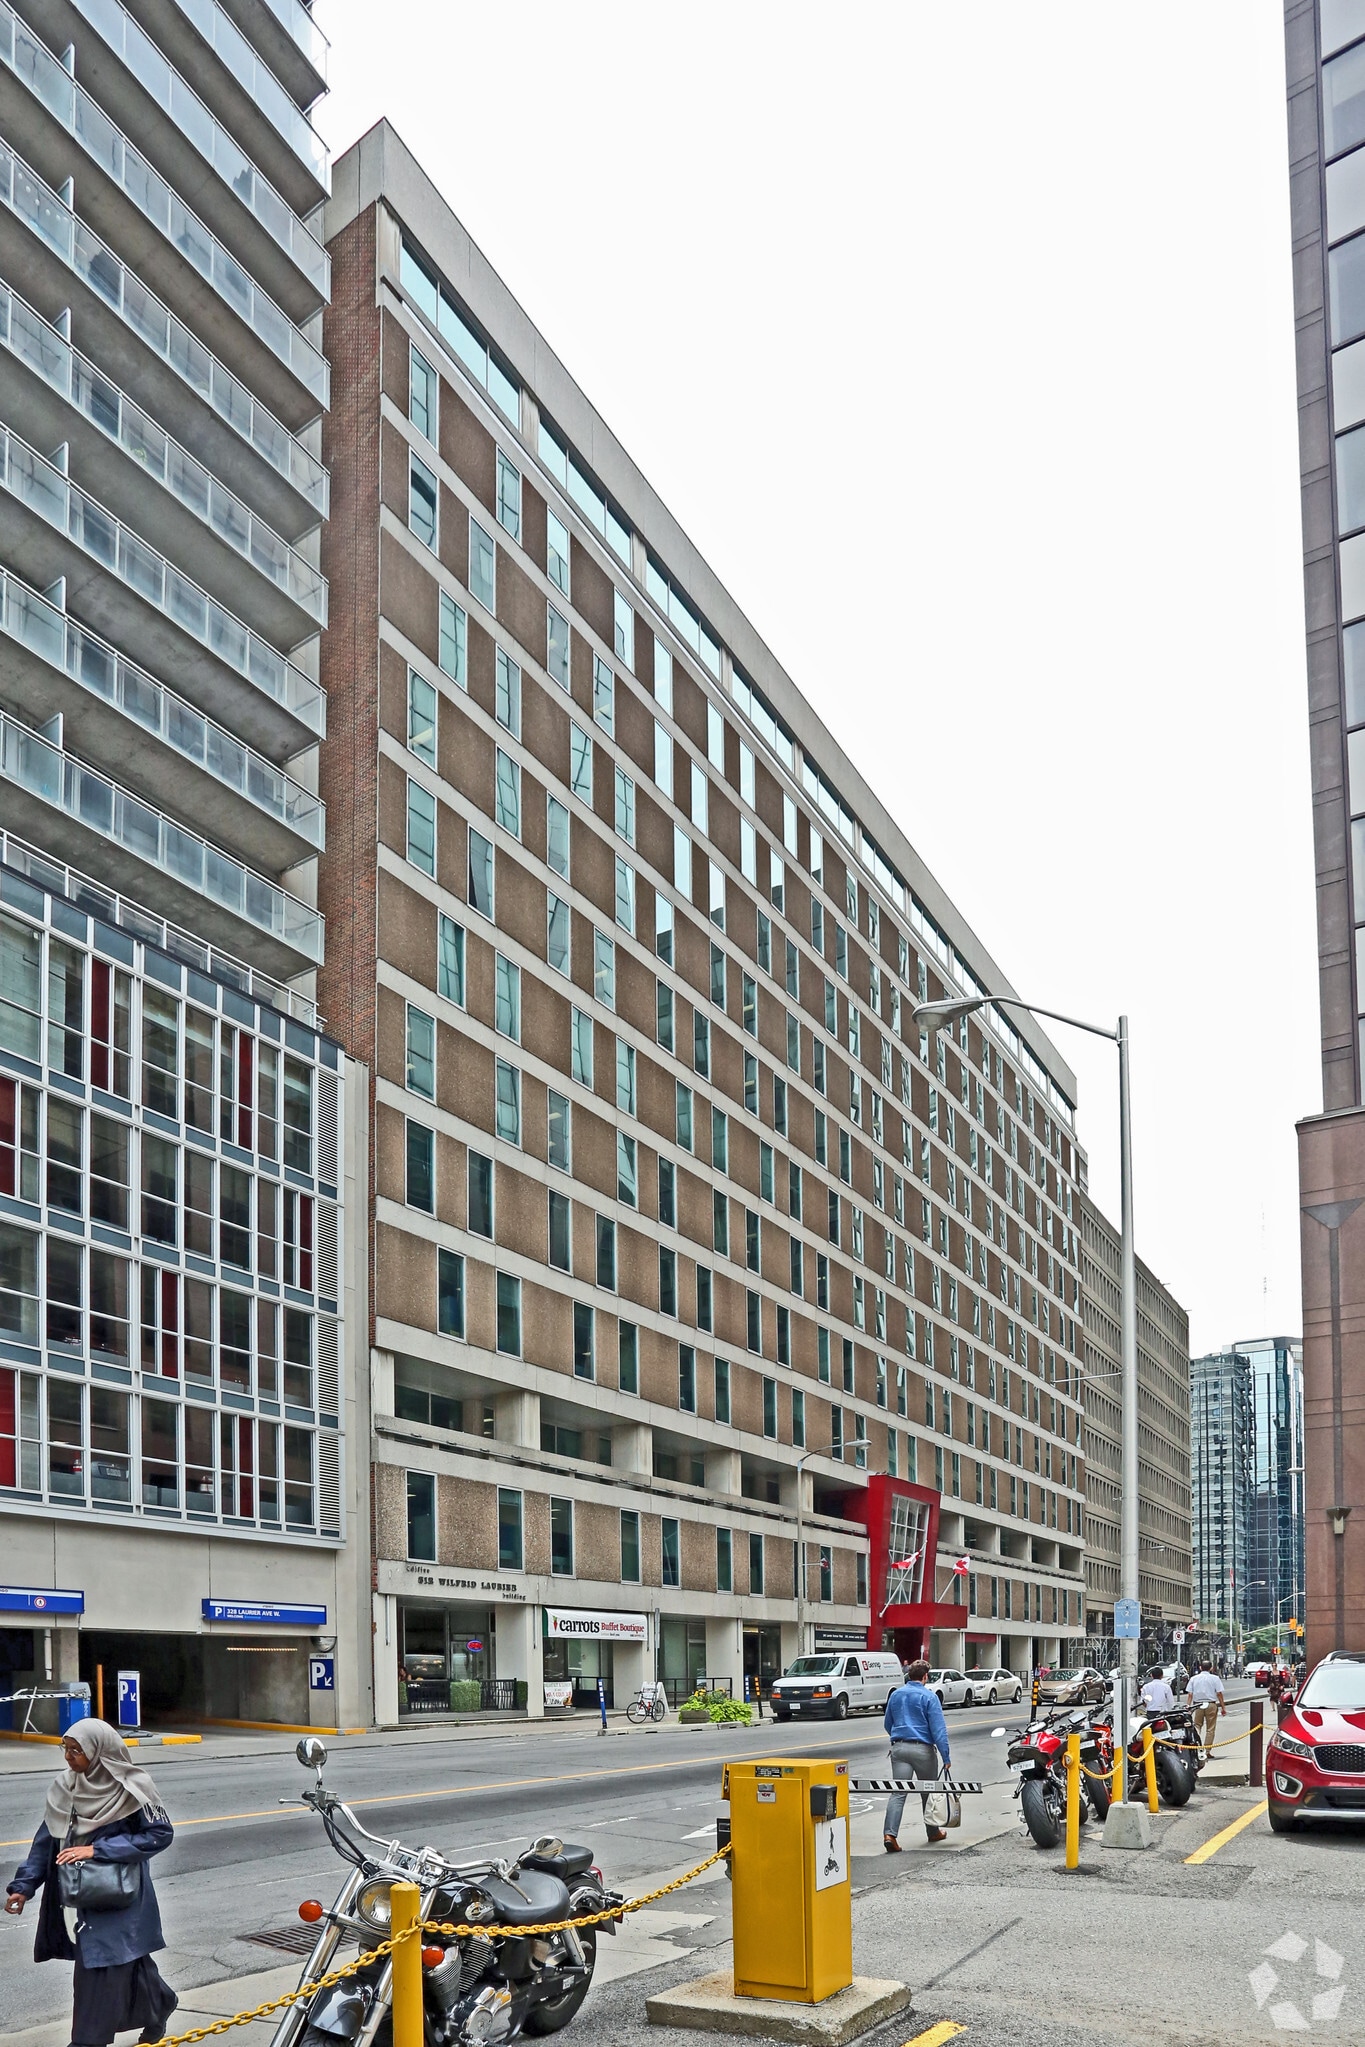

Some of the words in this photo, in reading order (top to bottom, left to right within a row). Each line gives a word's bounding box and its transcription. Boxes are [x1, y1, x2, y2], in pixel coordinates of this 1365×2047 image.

[418, 1576, 434, 1585] SIR
[438, 1578, 477, 1588] WILFRID
[481, 1582, 517, 1592] LAURIER
[502, 1593, 526, 1601] building
[215, 1607, 223, 1617] P
[559, 1619, 600, 1634] carrots
[601, 1622, 619, 1631] Buffet
[620, 1623, 645, 1634] Boutique
[312, 1662, 326, 1686] P
[119, 1681, 129, 1701] P
